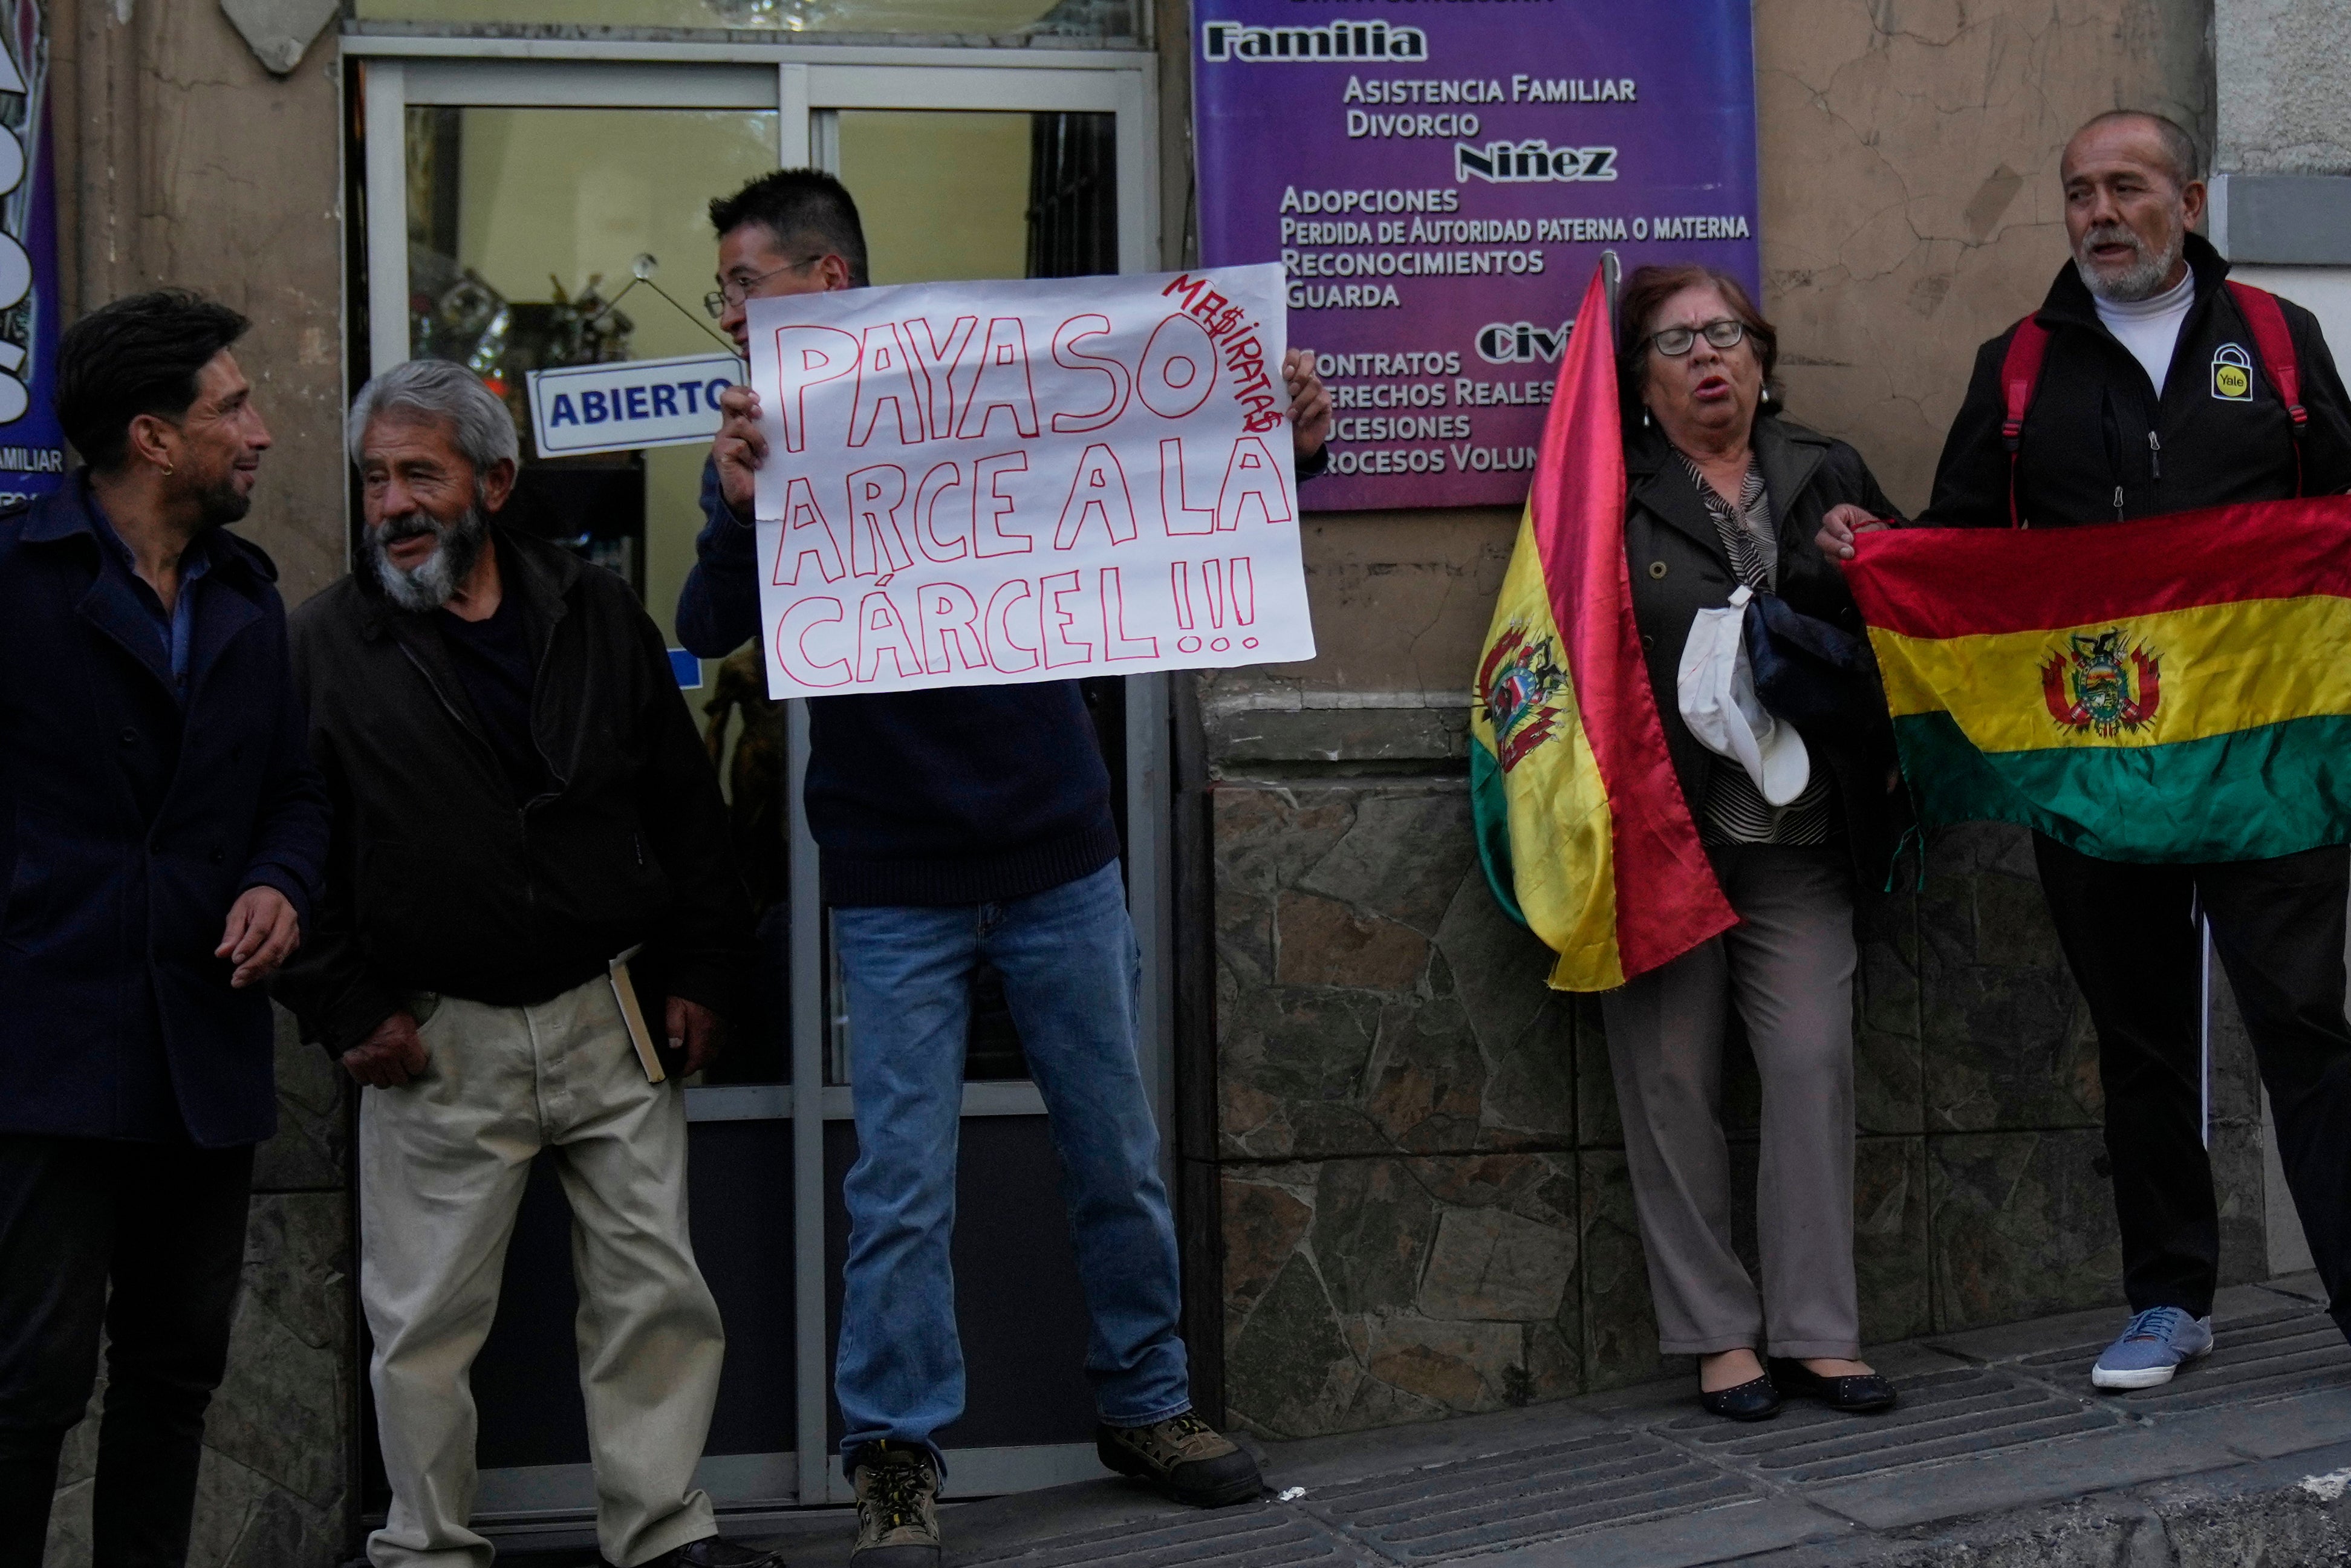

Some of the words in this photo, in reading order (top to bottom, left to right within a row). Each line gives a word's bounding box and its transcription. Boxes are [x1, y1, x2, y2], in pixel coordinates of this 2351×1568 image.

[1204, 20, 1428, 62] Familia
[1343, 76, 1503, 104] ASISTENCIA
[1512, 74, 1636, 103] FAMILIAR
[1347, 109, 1480, 138] DIVORCIO
[1455, 140, 1618, 184] Niñez
[1280, 186, 1458, 213] ADOPCIONES
[1281, 216, 1374, 245] PERDIDA
[1377, 221, 1406, 243] DE
[1409, 216, 1532, 243] AUTORIDAD
[1536, 218, 1628, 241] PATERNA
[1632, 217, 1648, 240] O
[1653, 216, 1750, 240] MATERNA
[1281, 249, 1544, 276] RECONOCIMIENTOS
[1286, 280, 1401, 309] GUARDA
[1474, 320, 1575, 365] Civ
[1315, 351, 1462, 378] ONTRATOS
[775, 312, 1217, 452] PAYASO
[1324, 383, 1447, 409] ERECHOS
[1455, 377, 1555, 406] REALES
[2220, 374, 2244, 387] Yale
[550, 378, 733, 428] ABIERTO
[1324, 449, 1446, 475] ROCESOS
[773, 450, 1033, 585] ARCE
[1053, 443, 1137, 550] A
[1160, 436, 1292, 536] LA
